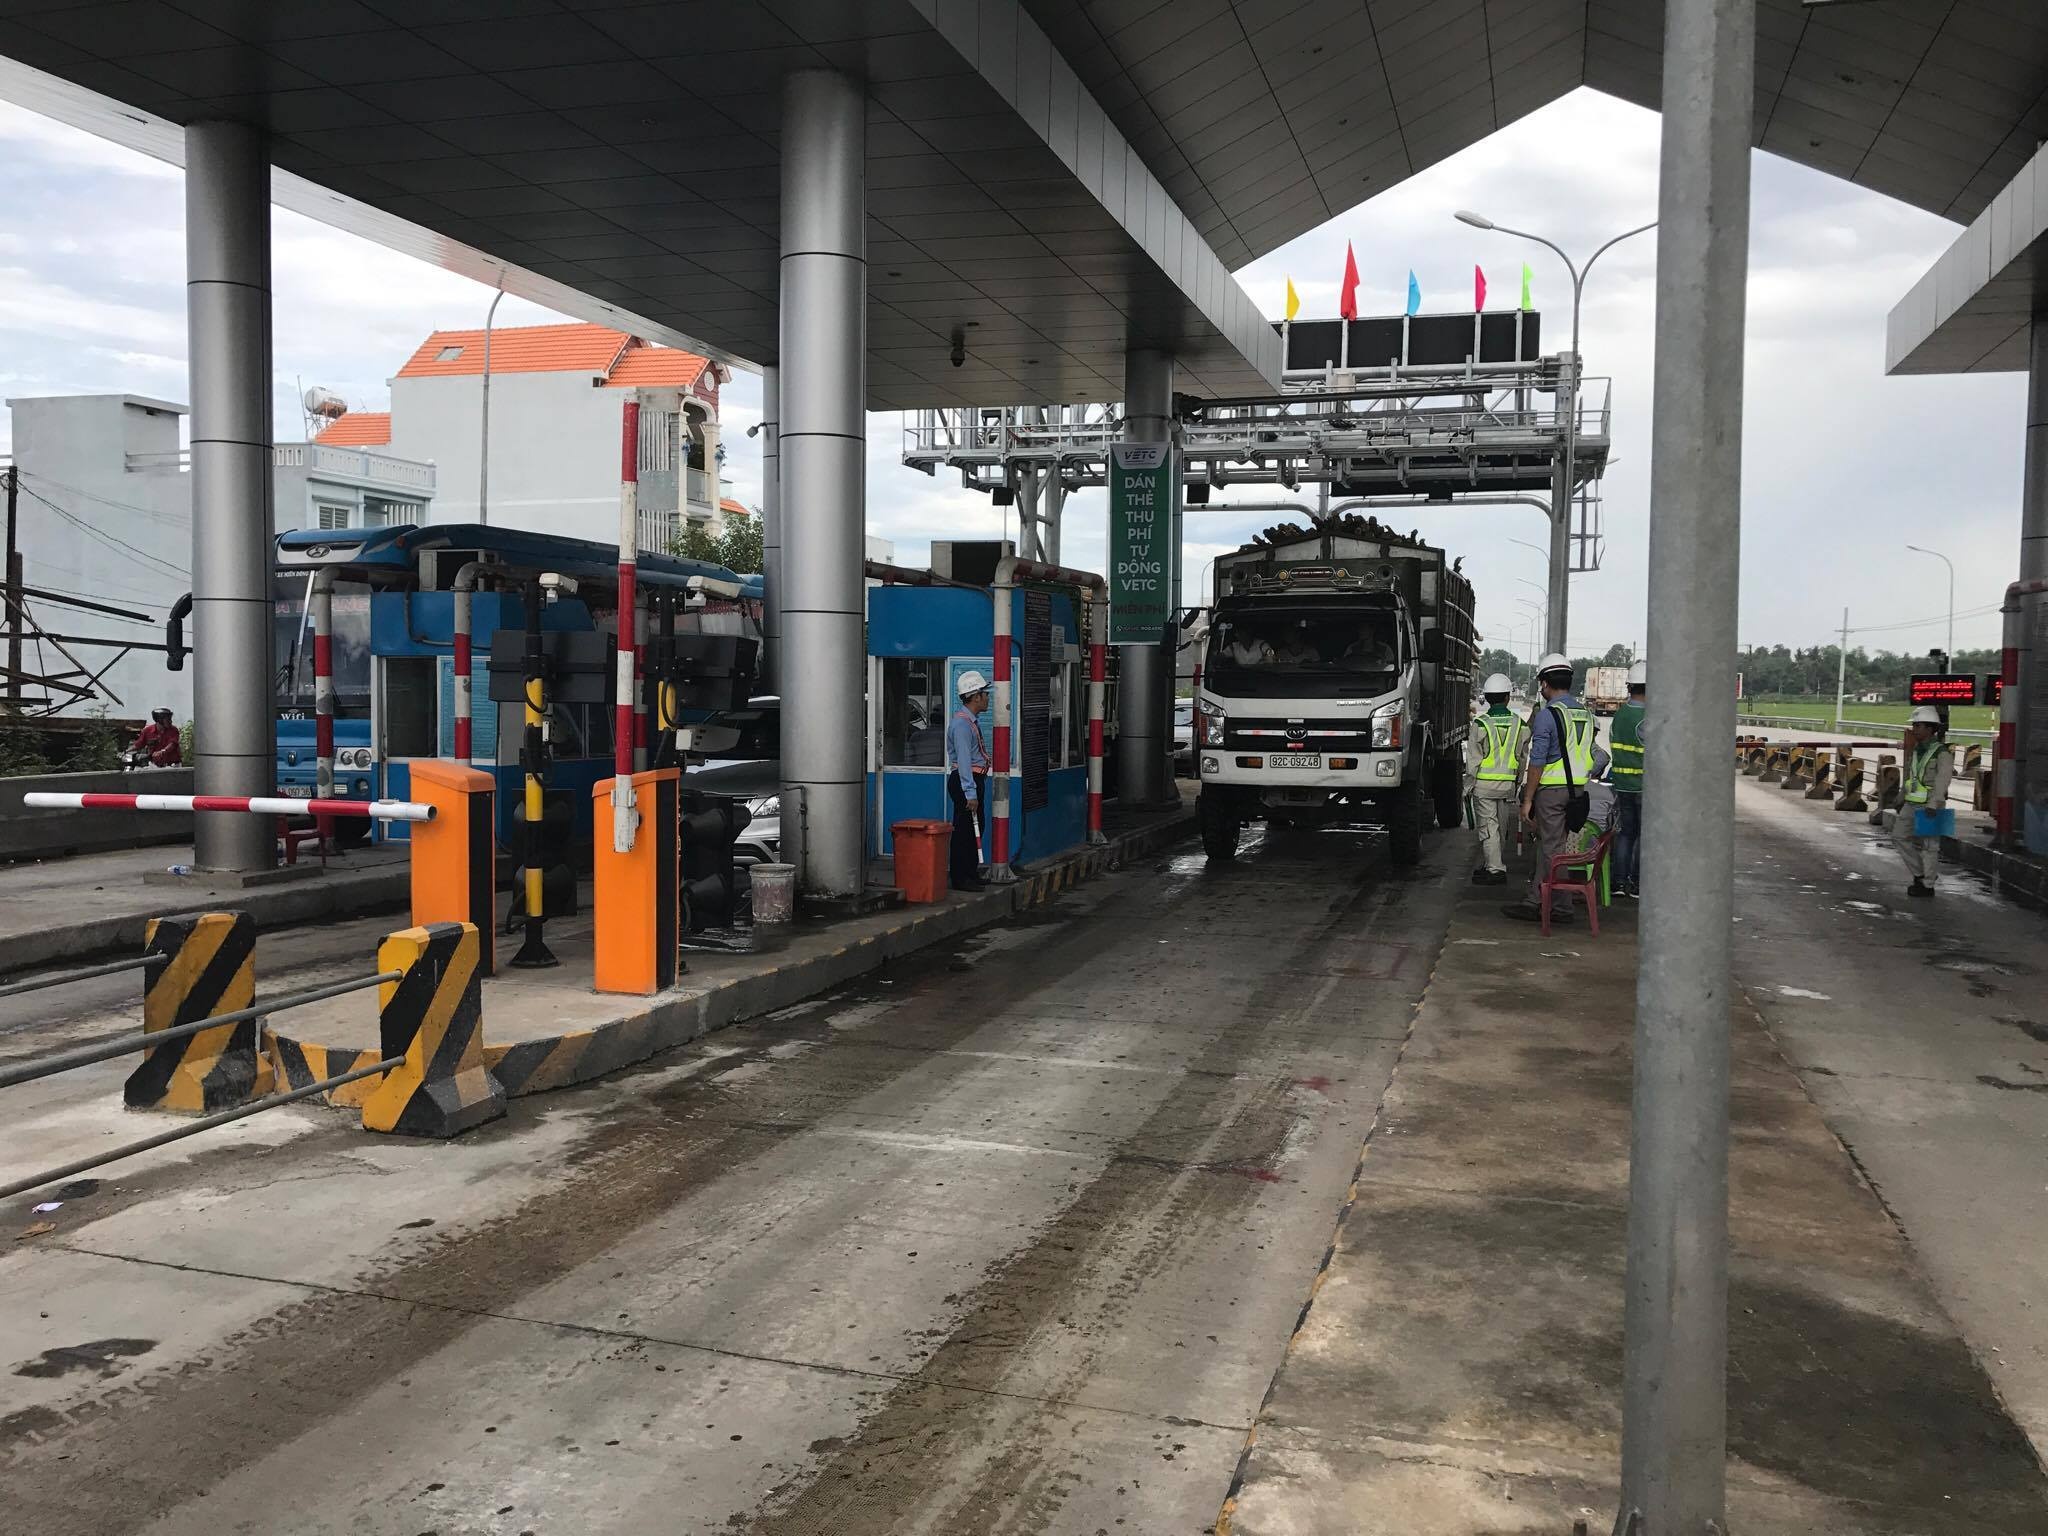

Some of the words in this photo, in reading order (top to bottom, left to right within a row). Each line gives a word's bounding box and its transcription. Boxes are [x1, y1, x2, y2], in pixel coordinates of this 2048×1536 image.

[1124, 451, 1157, 460] VETC
[1124, 474, 1156, 489] DÁN
[1126, 490, 1154, 506] THẺ
[1125, 511, 1154, 523] THU
[1127, 524, 1152, 540] PHÍ
[1130, 544, 1150, 560] TỰ
[1117, 559, 1161, 578] ĐỘNG
[1121, 579, 1157, 591] VETC
